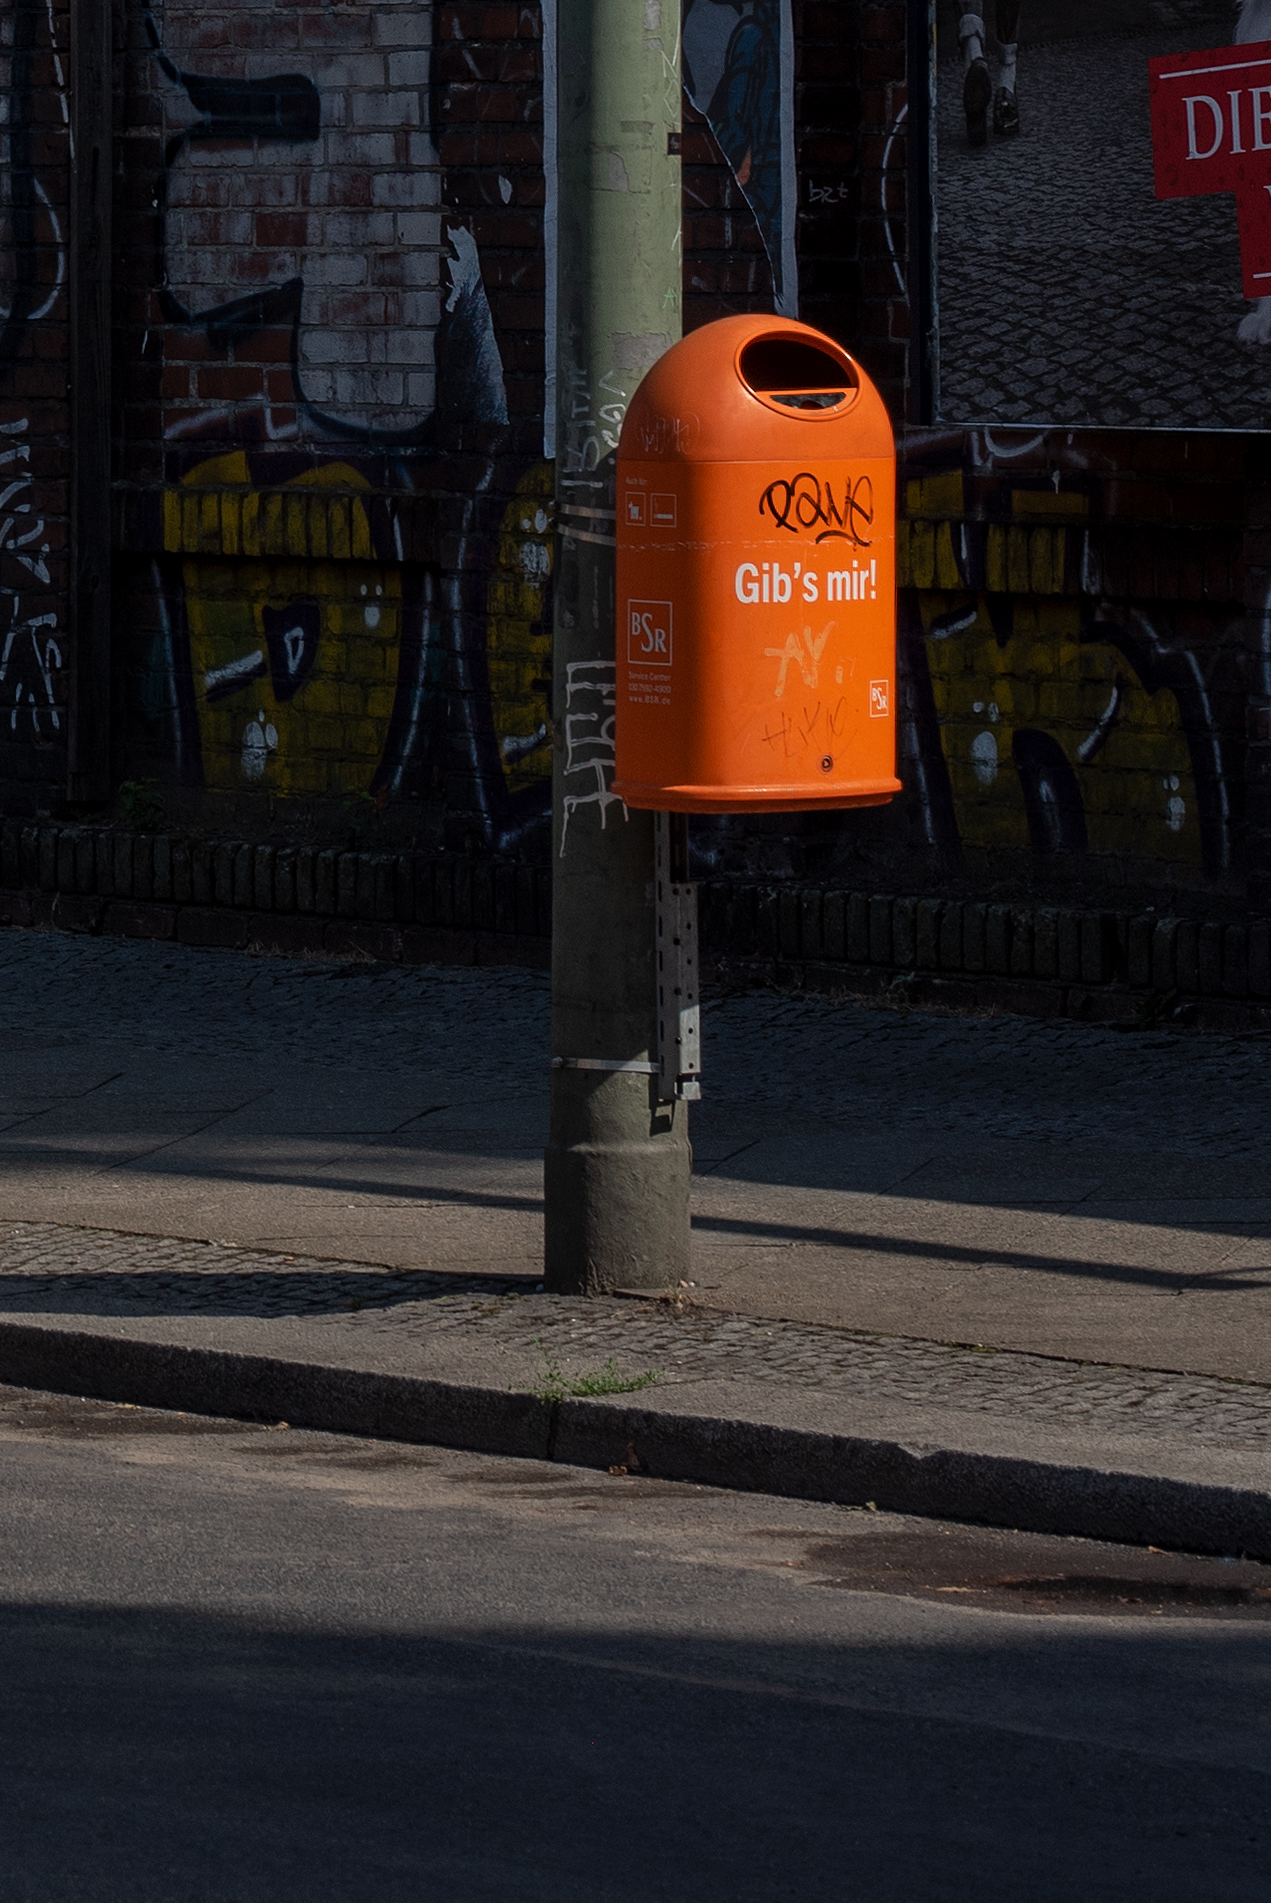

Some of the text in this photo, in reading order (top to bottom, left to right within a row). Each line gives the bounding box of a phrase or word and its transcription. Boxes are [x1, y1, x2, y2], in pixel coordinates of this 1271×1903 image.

[826, 558, 877, 602] mir!
[631, 611, 667, 653] BSR
[870, 686, 888, 711] BSR
